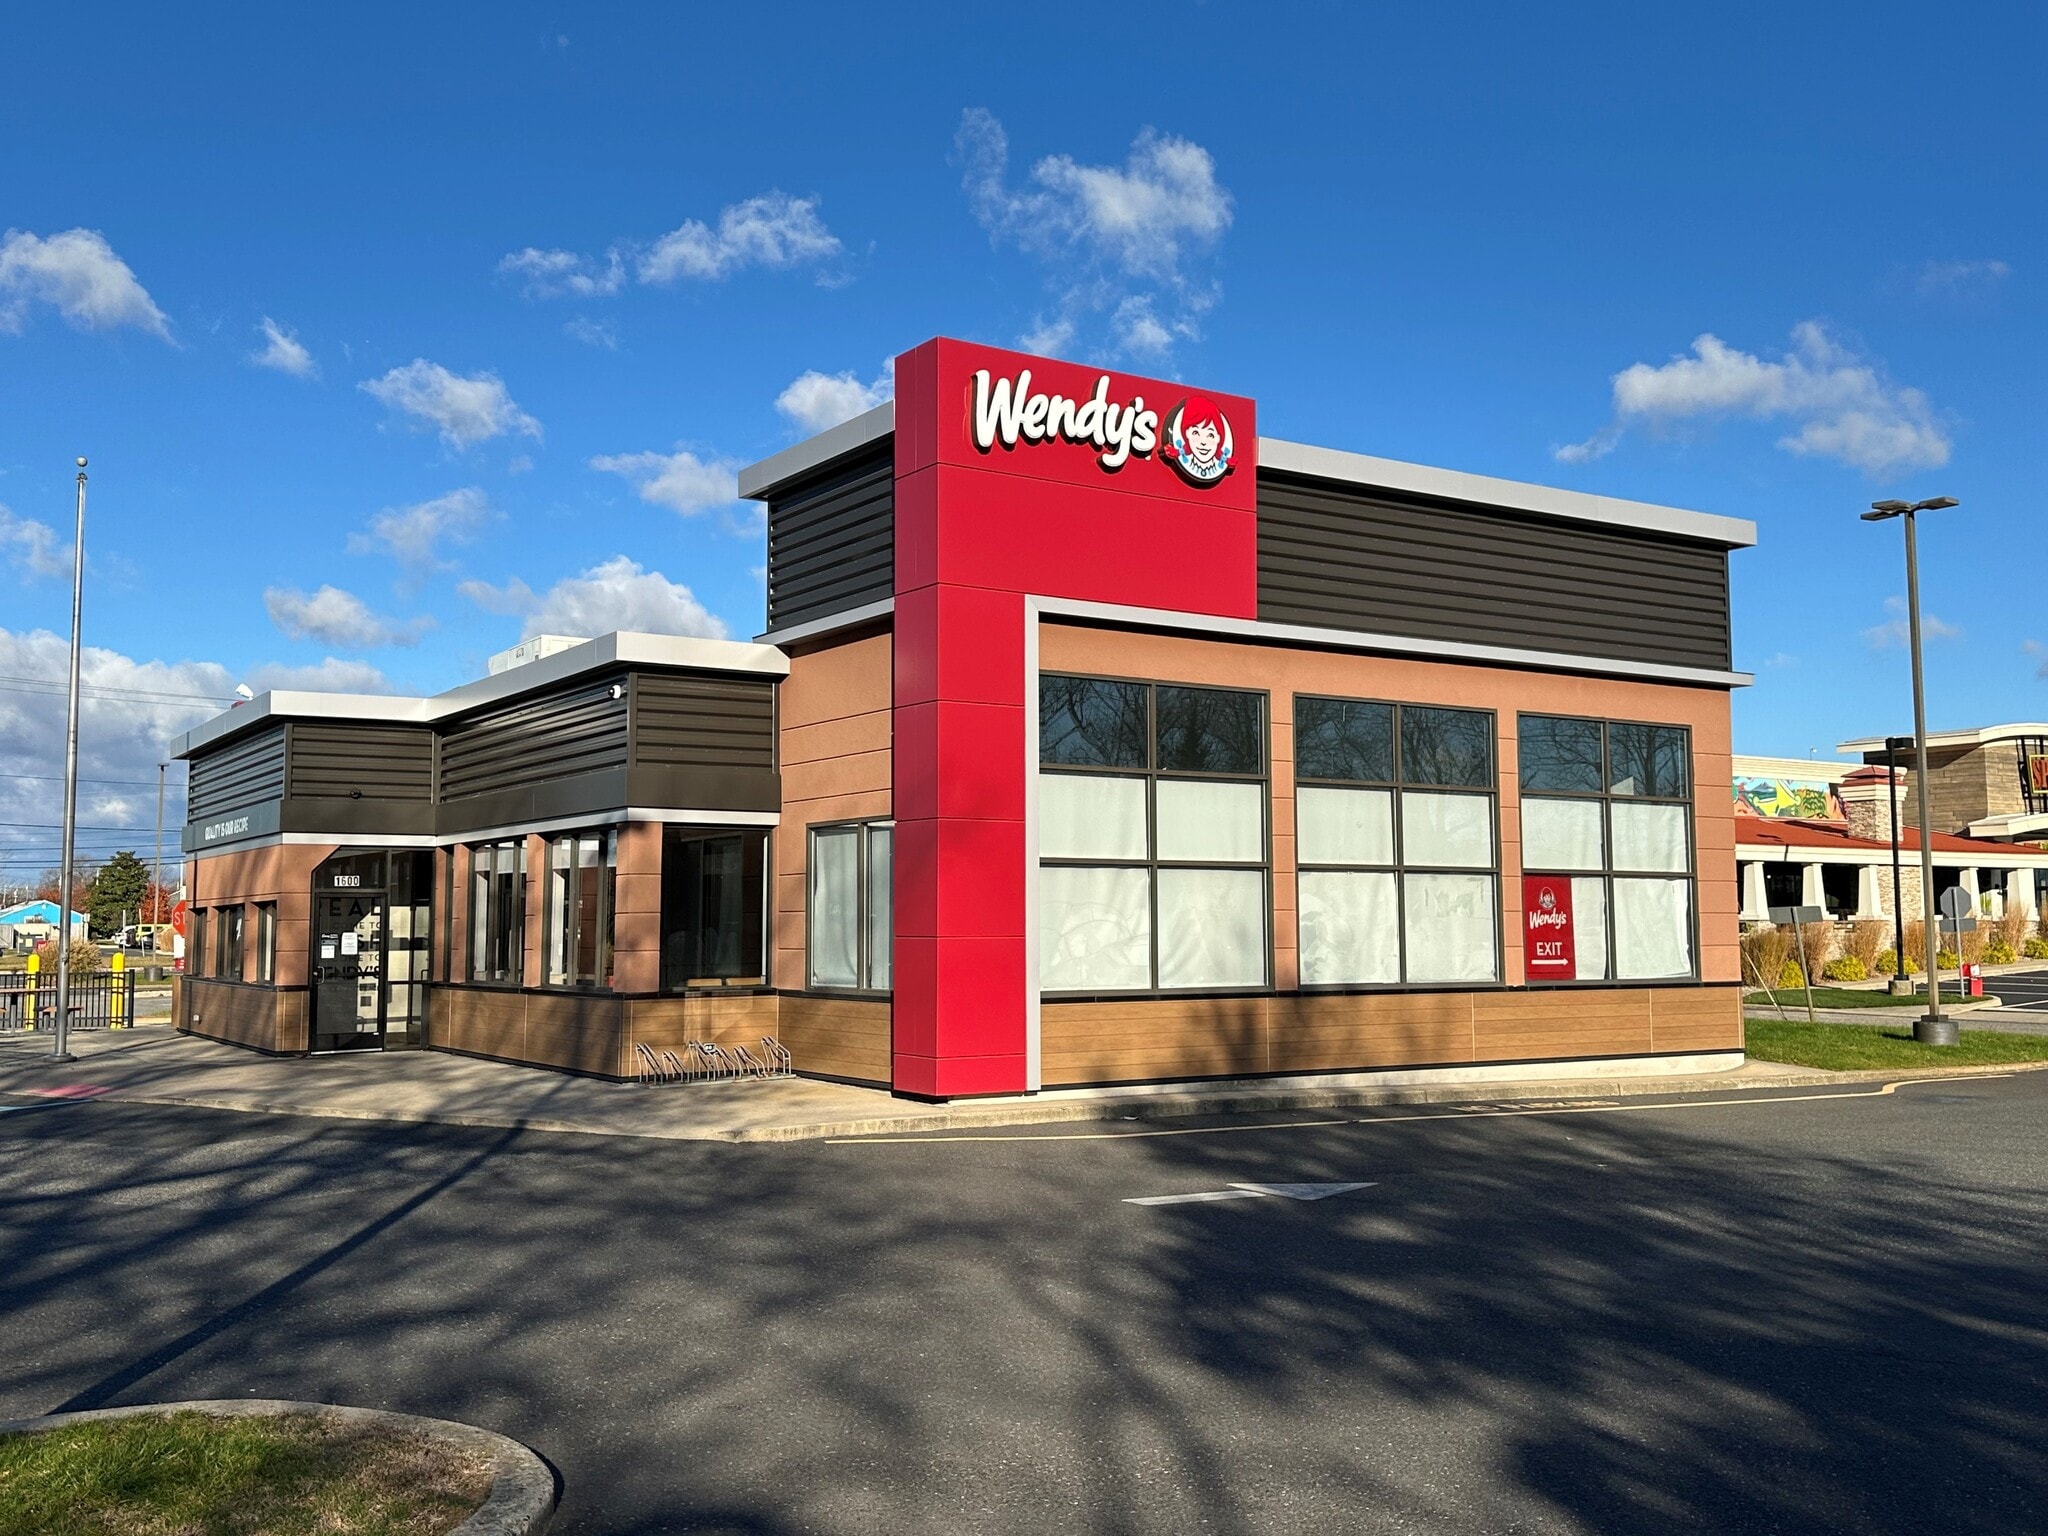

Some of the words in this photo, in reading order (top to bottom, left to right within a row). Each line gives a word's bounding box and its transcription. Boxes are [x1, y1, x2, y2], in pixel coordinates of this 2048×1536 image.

[974, 369, 1159, 468] Wendy's
[336, 876, 359, 886] 1600
[320, 897, 380, 917] EAL
[1529, 908, 1567, 929] Wendy's
[1536, 942, 1562, 956] EXIT
